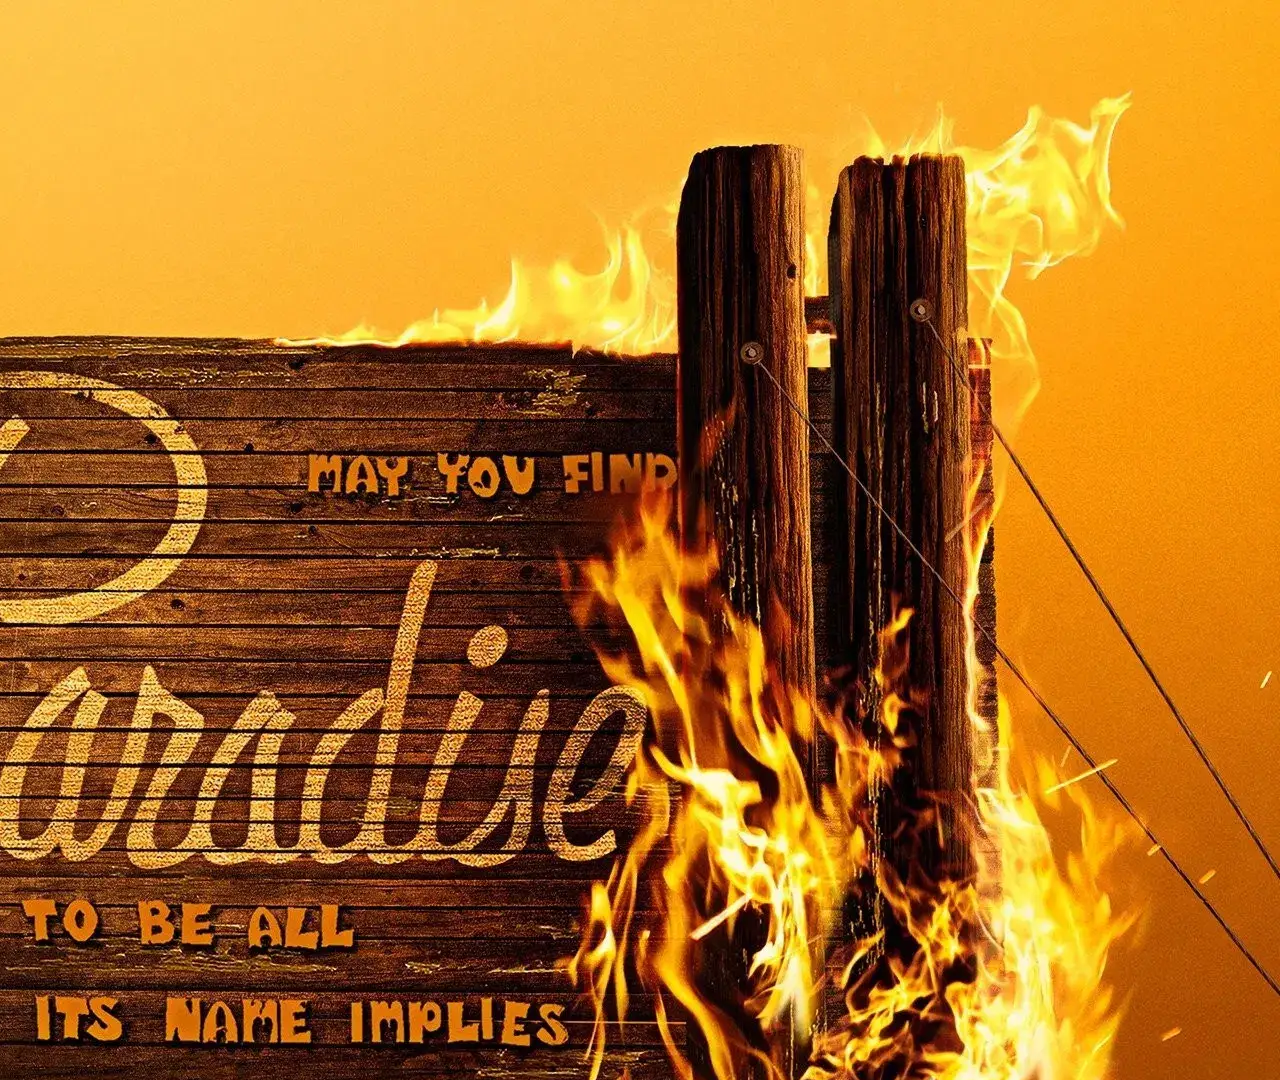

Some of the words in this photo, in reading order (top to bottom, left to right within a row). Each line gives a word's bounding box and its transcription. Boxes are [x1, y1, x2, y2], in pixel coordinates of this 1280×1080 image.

[308, 452, 408, 496] MAY
[438, 452, 535, 497] YOU
[563, 452, 679, 494] FIND
[23, 899, 98, 942] TO
[138, 900, 212, 946] BE
[248, 904, 355, 949] ALL
[35, 996, 122, 1041] ITS
[165, 996, 311, 1043] NAME
[351, 997, 570, 1046] IMPLIES
